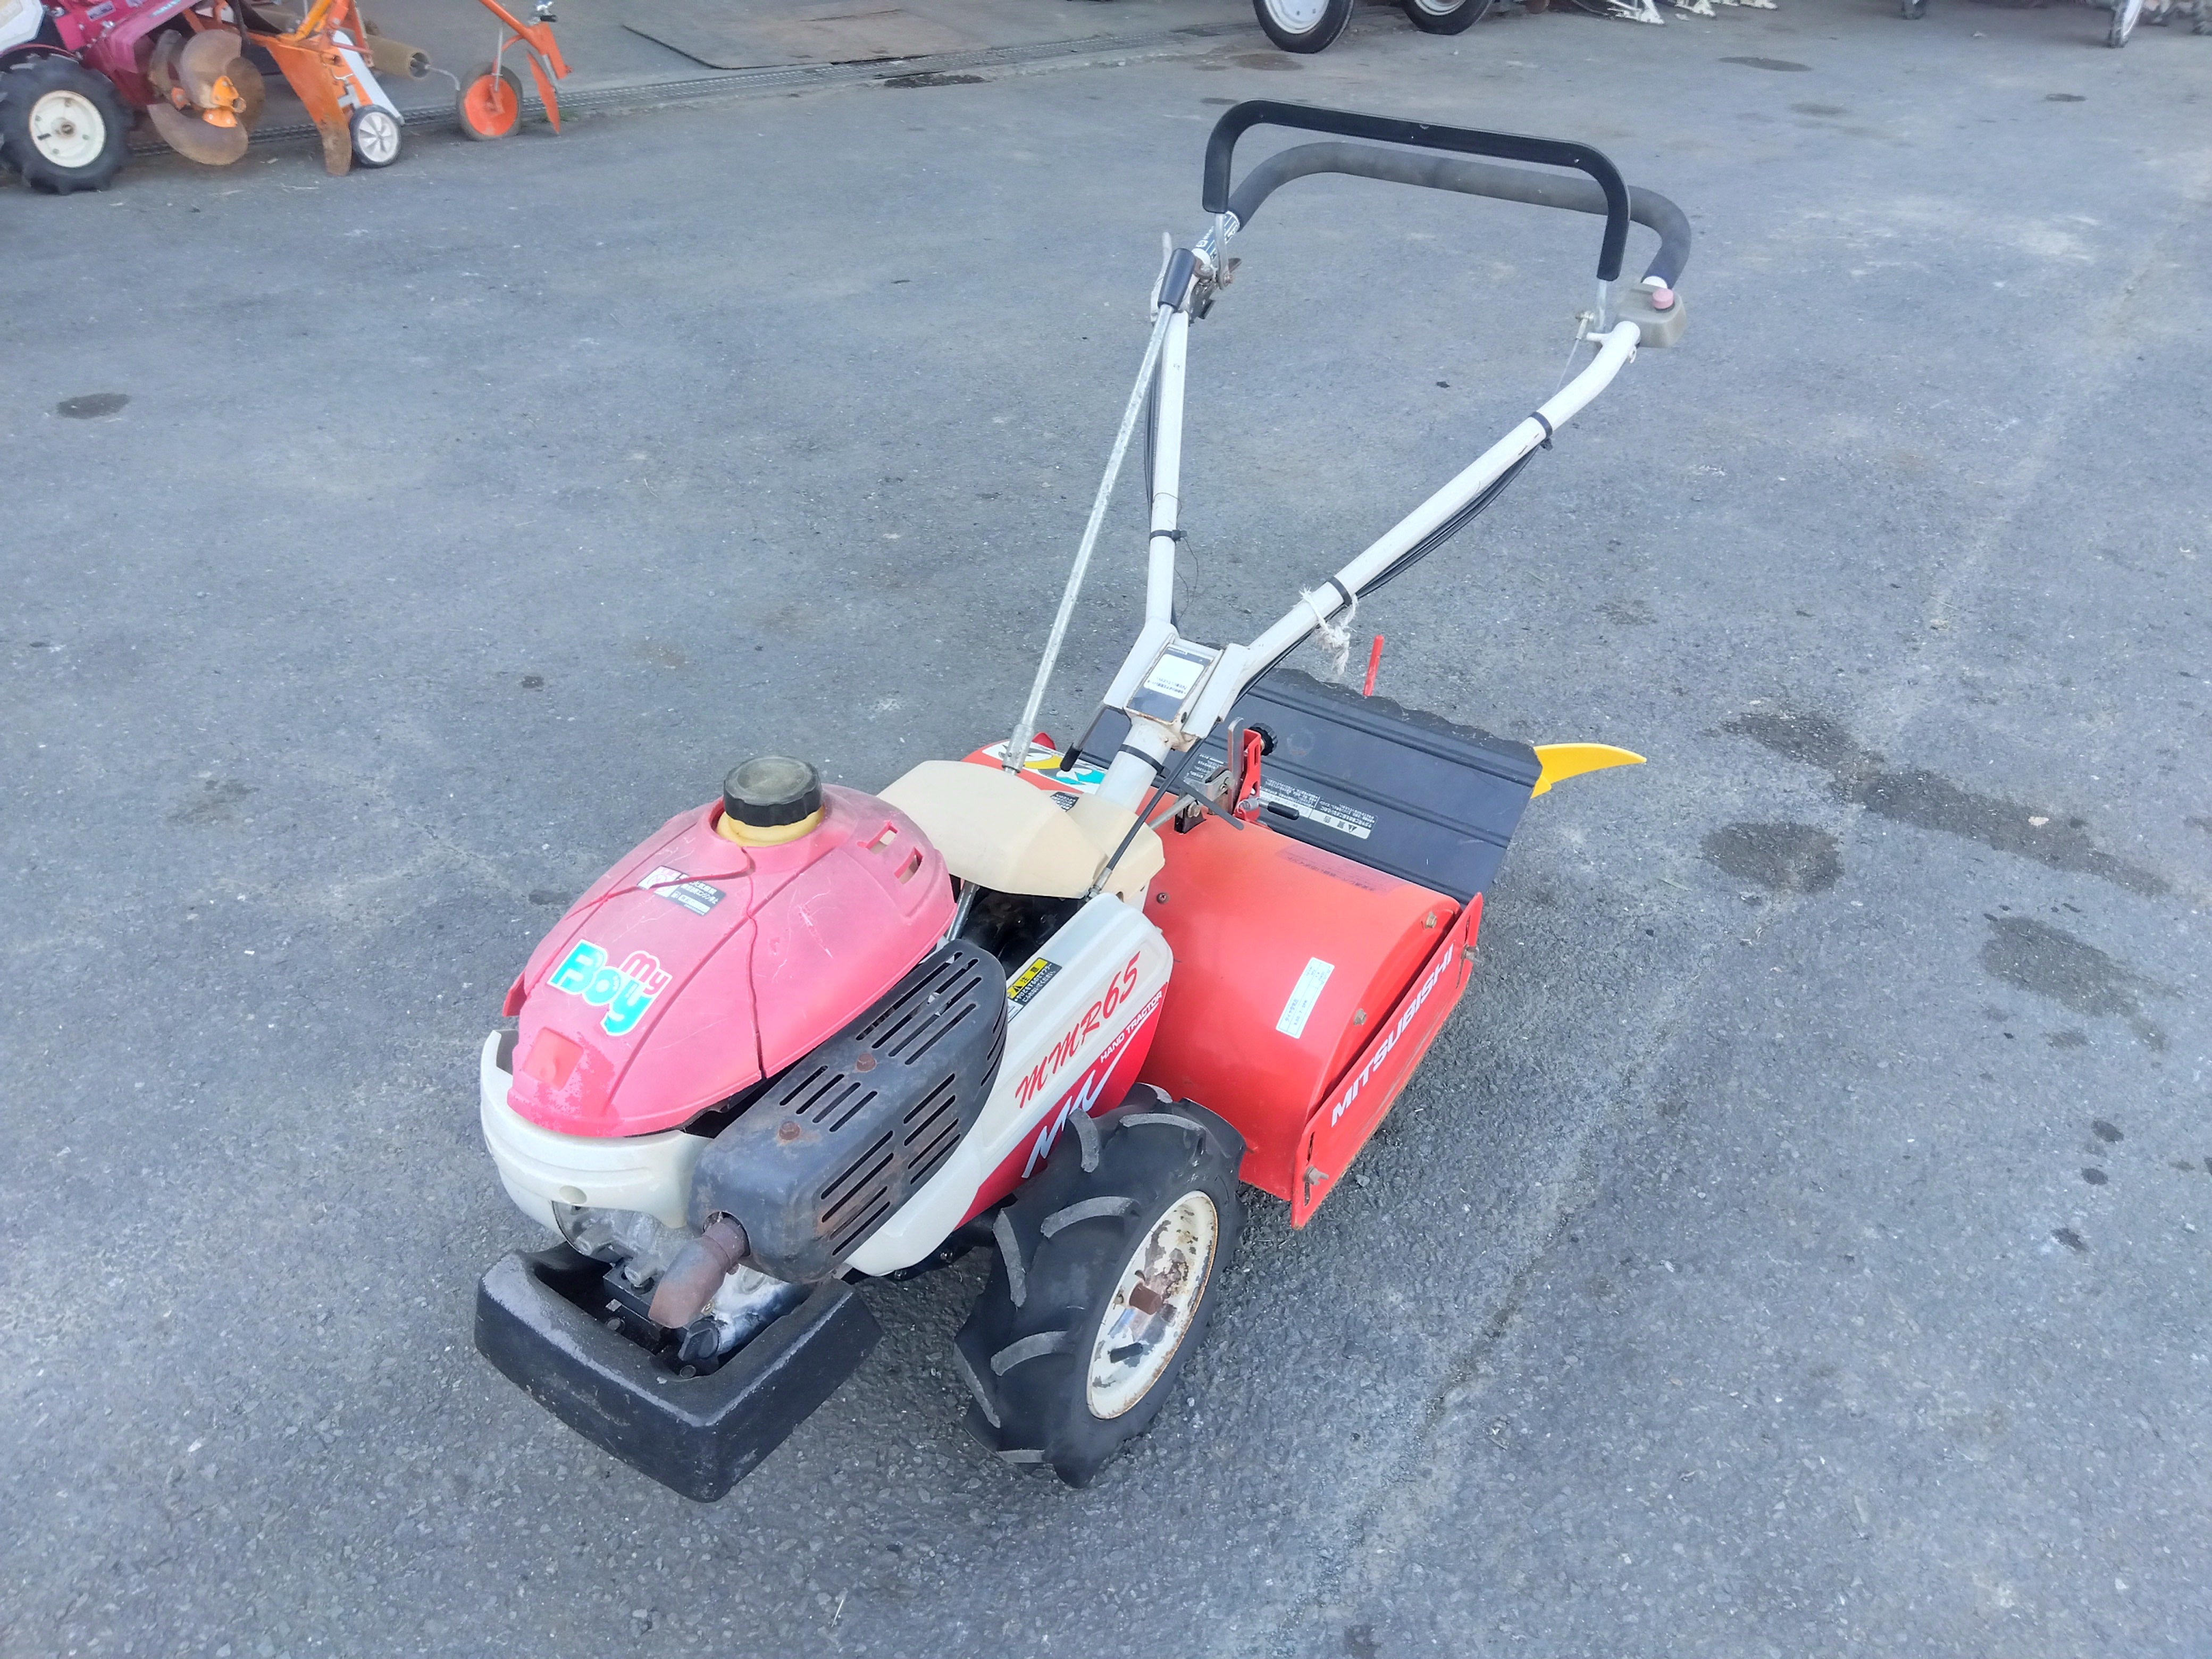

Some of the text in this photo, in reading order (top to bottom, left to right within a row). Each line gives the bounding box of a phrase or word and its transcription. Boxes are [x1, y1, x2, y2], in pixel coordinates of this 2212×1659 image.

[549, 941, 653, 1034] Boy
[1015, 951, 1141, 1109] MMR65
[1100, 990, 1162, 1063] HAND TRACTOR
[1331, 943, 1454, 1128] MITSUBISHI
